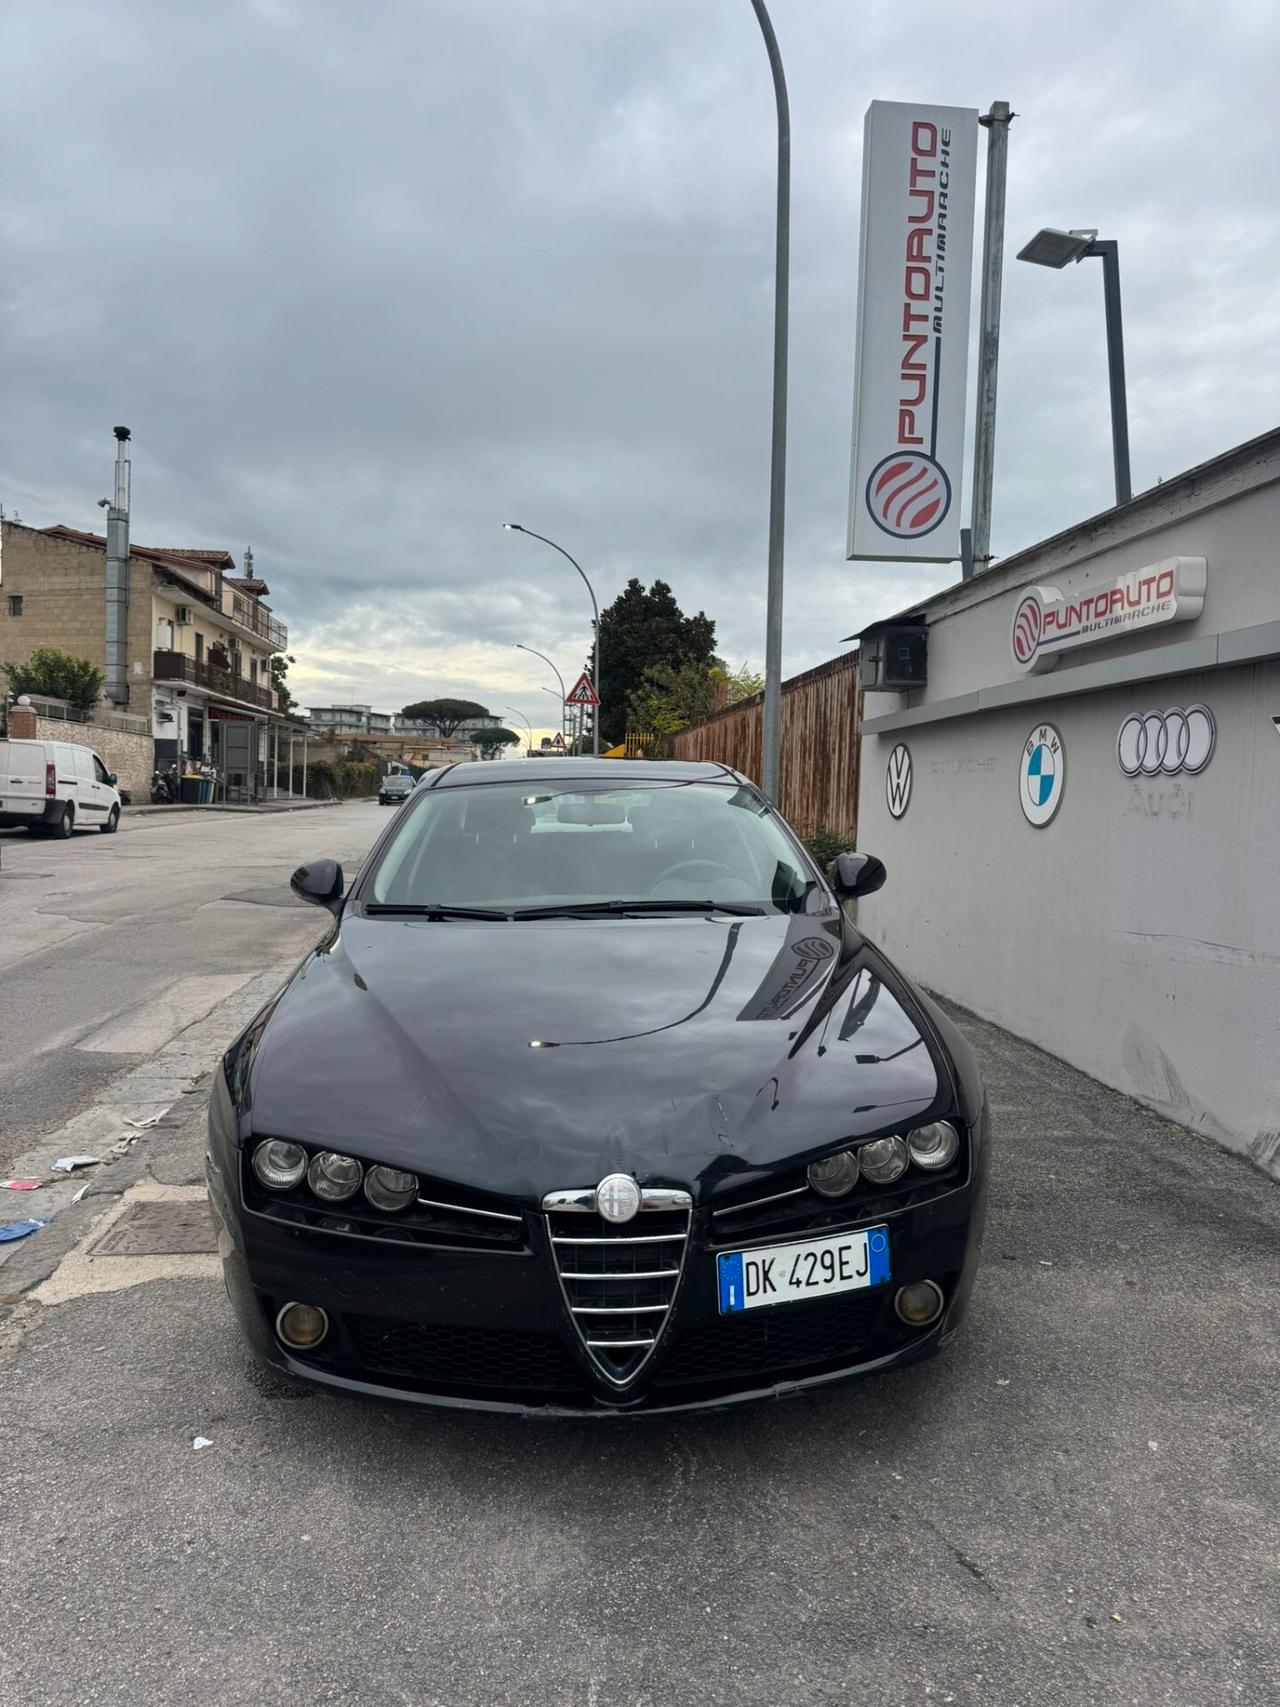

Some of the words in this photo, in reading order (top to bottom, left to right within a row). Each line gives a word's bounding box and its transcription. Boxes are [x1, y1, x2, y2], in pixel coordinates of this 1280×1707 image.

[932, 127, 952, 334] MULTIMARCHE
[897, 120, 938, 445] PUNTOAUTO
[1042, 570, 1174, 635] PUNTOAUTO
[1081, 600, 1171, 633] MULTIMARCHE
[1026, 728, 1060, 757] BMW
[745, 1257, 777, 1297] DK
[789, 1242, 869, 1289] 429EJ
